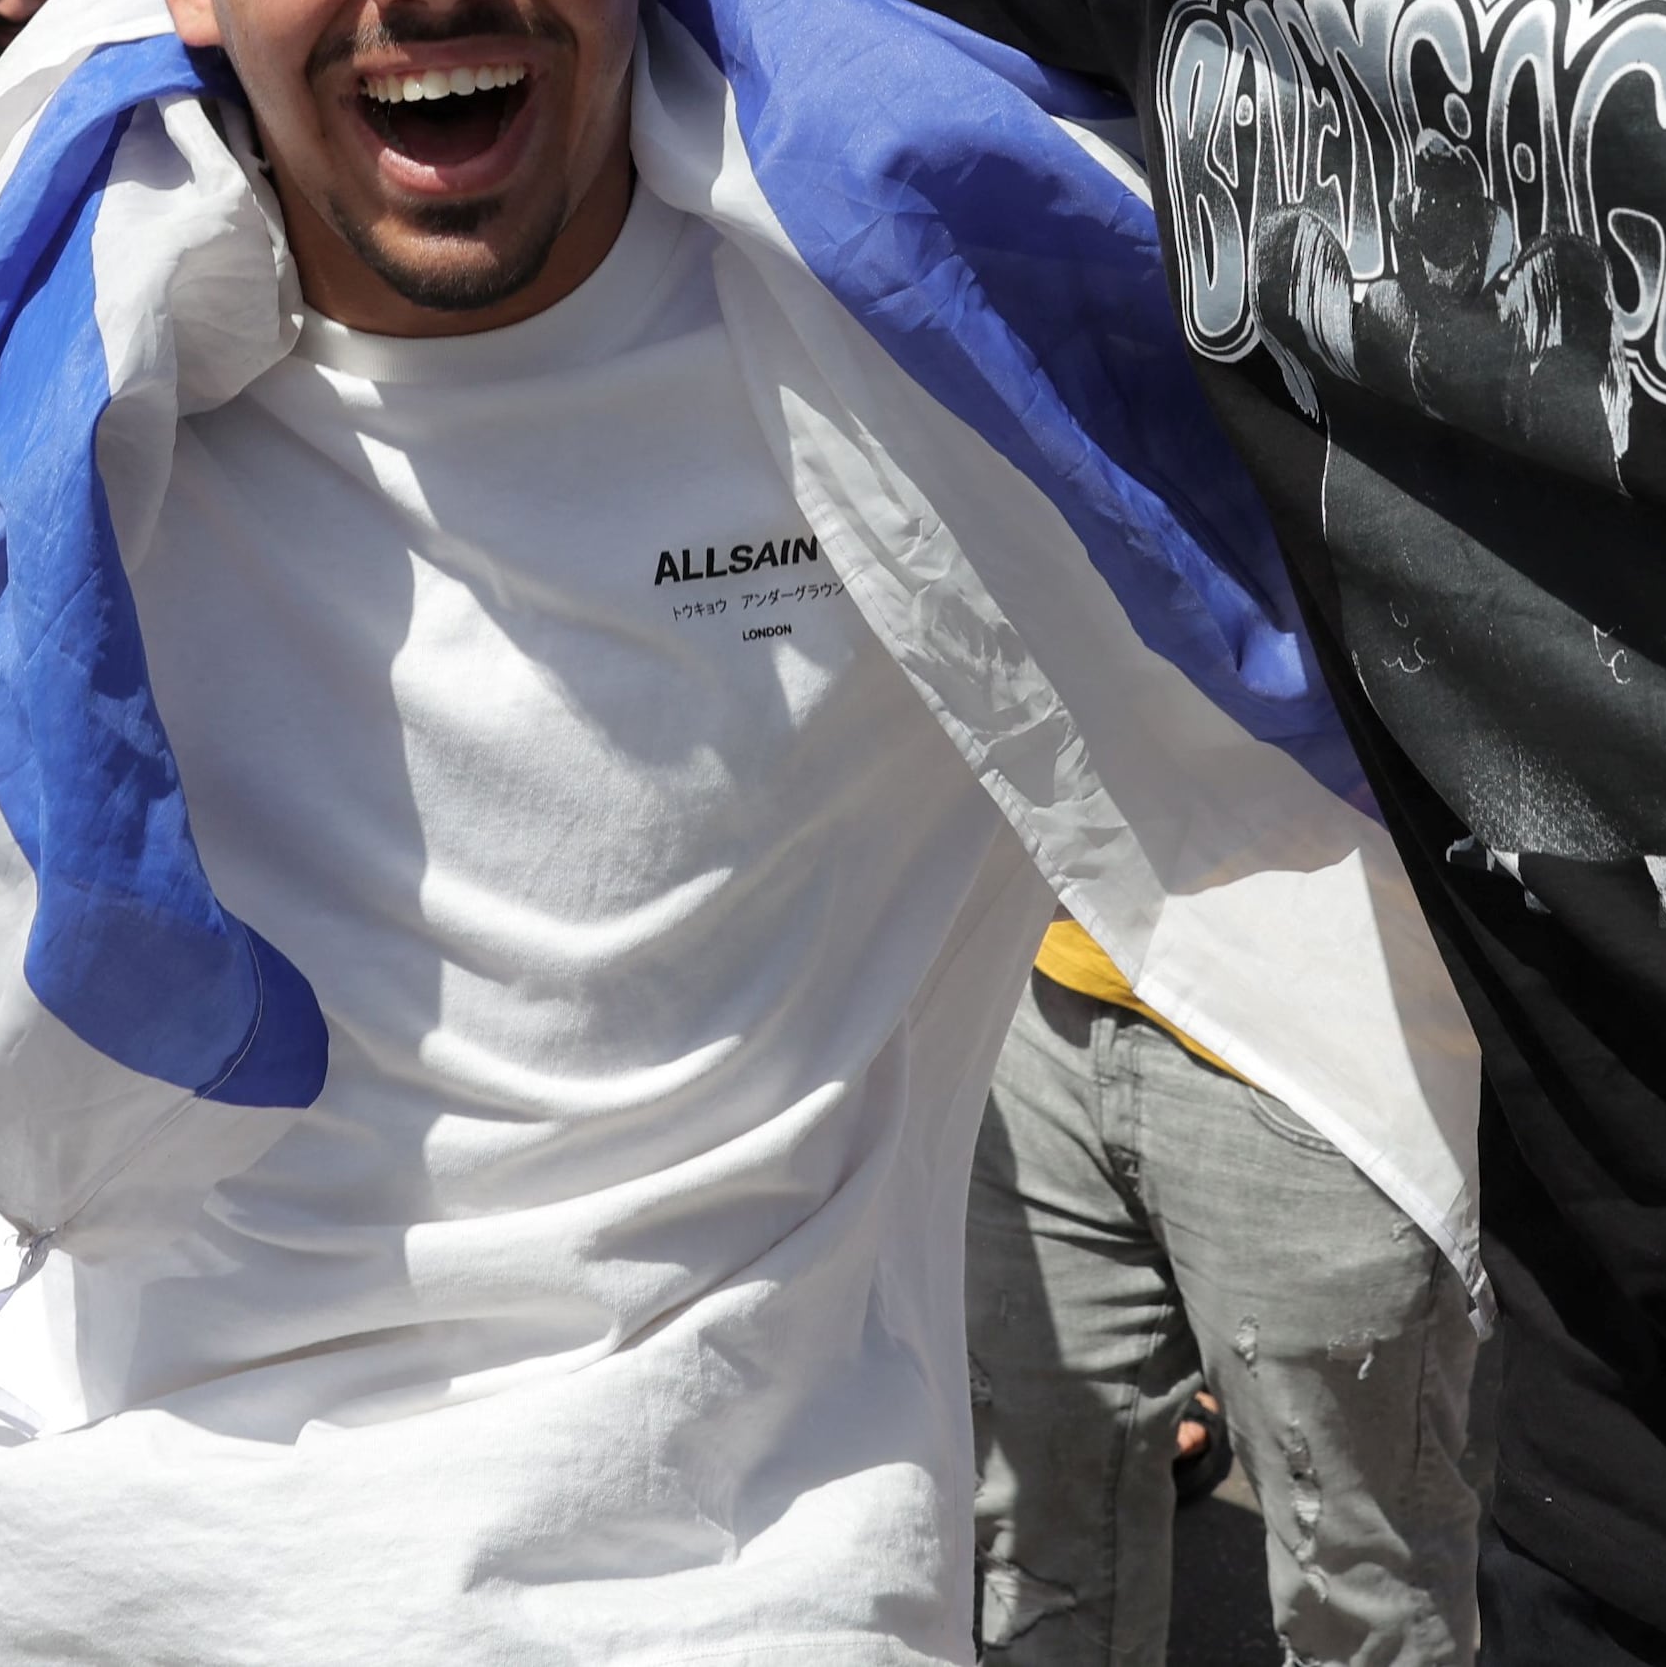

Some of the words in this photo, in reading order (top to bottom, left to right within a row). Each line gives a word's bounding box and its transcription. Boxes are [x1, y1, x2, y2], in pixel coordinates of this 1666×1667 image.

[654, 534, 818, 586] ALLSAIN
[672, 597, 727, 622] トウキョウ
[741, 581, 845, 610] アンダーグラウン
[742, 623, 792, 642] LONDON
